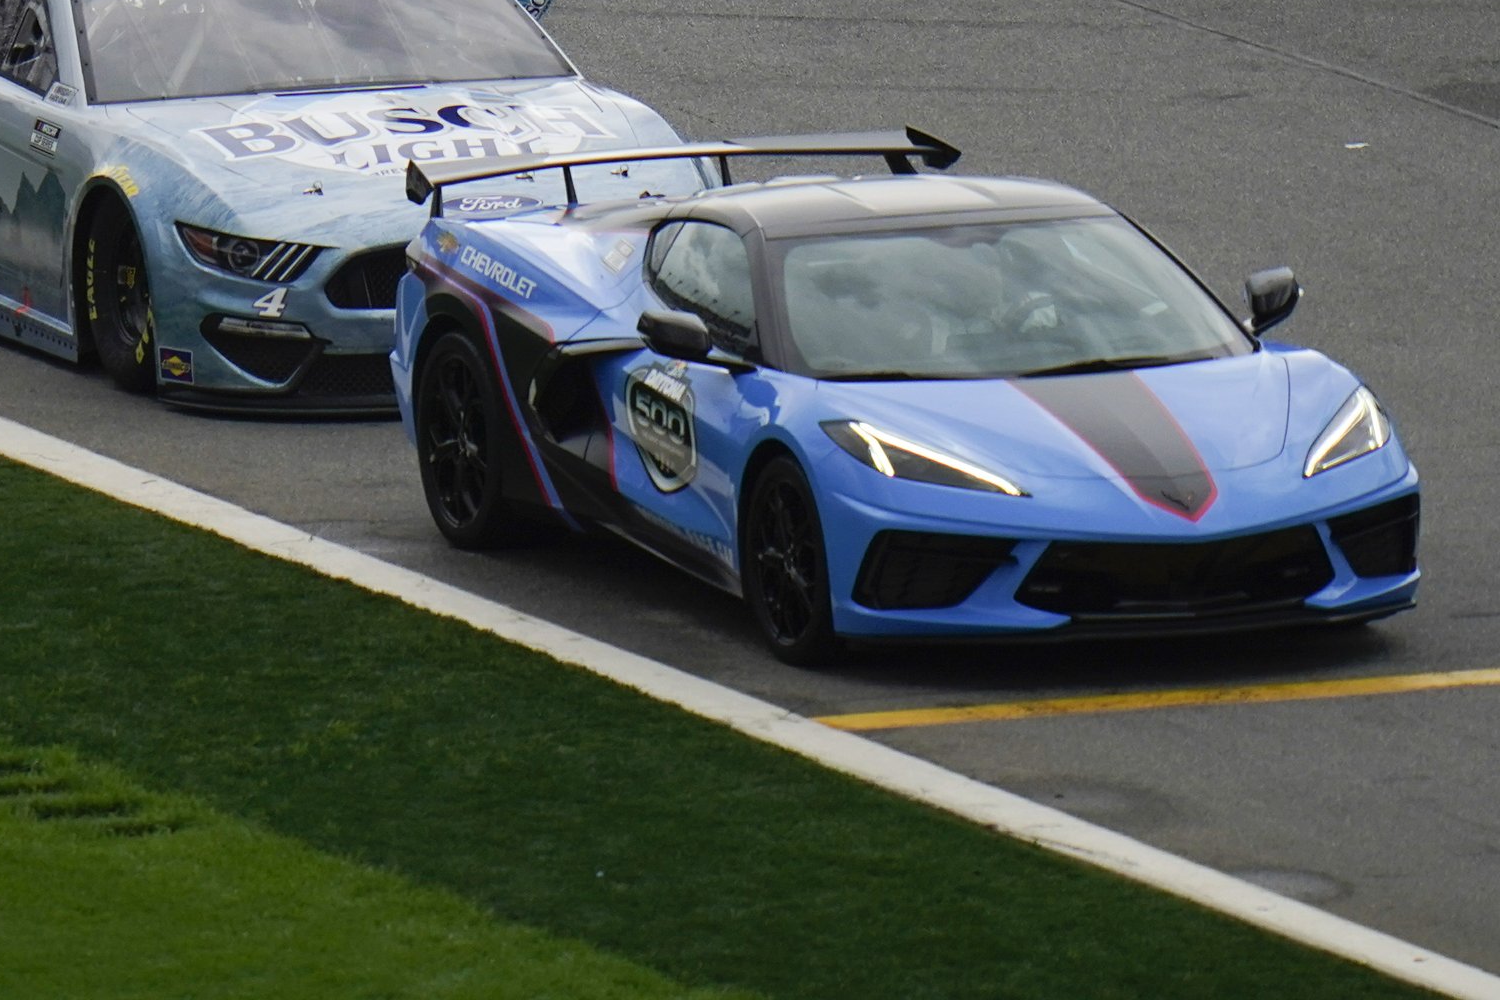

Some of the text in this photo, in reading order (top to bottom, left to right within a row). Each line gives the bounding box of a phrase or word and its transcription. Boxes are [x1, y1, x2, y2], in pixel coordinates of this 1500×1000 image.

[203, 103, 612, 160] BUSCH
[459, 193, 522, 212] Ford
[460, 244, 538, 300] CHEVROLET
[253, 287, 288, 317] 4
[635, 391, 685, 446] 500
